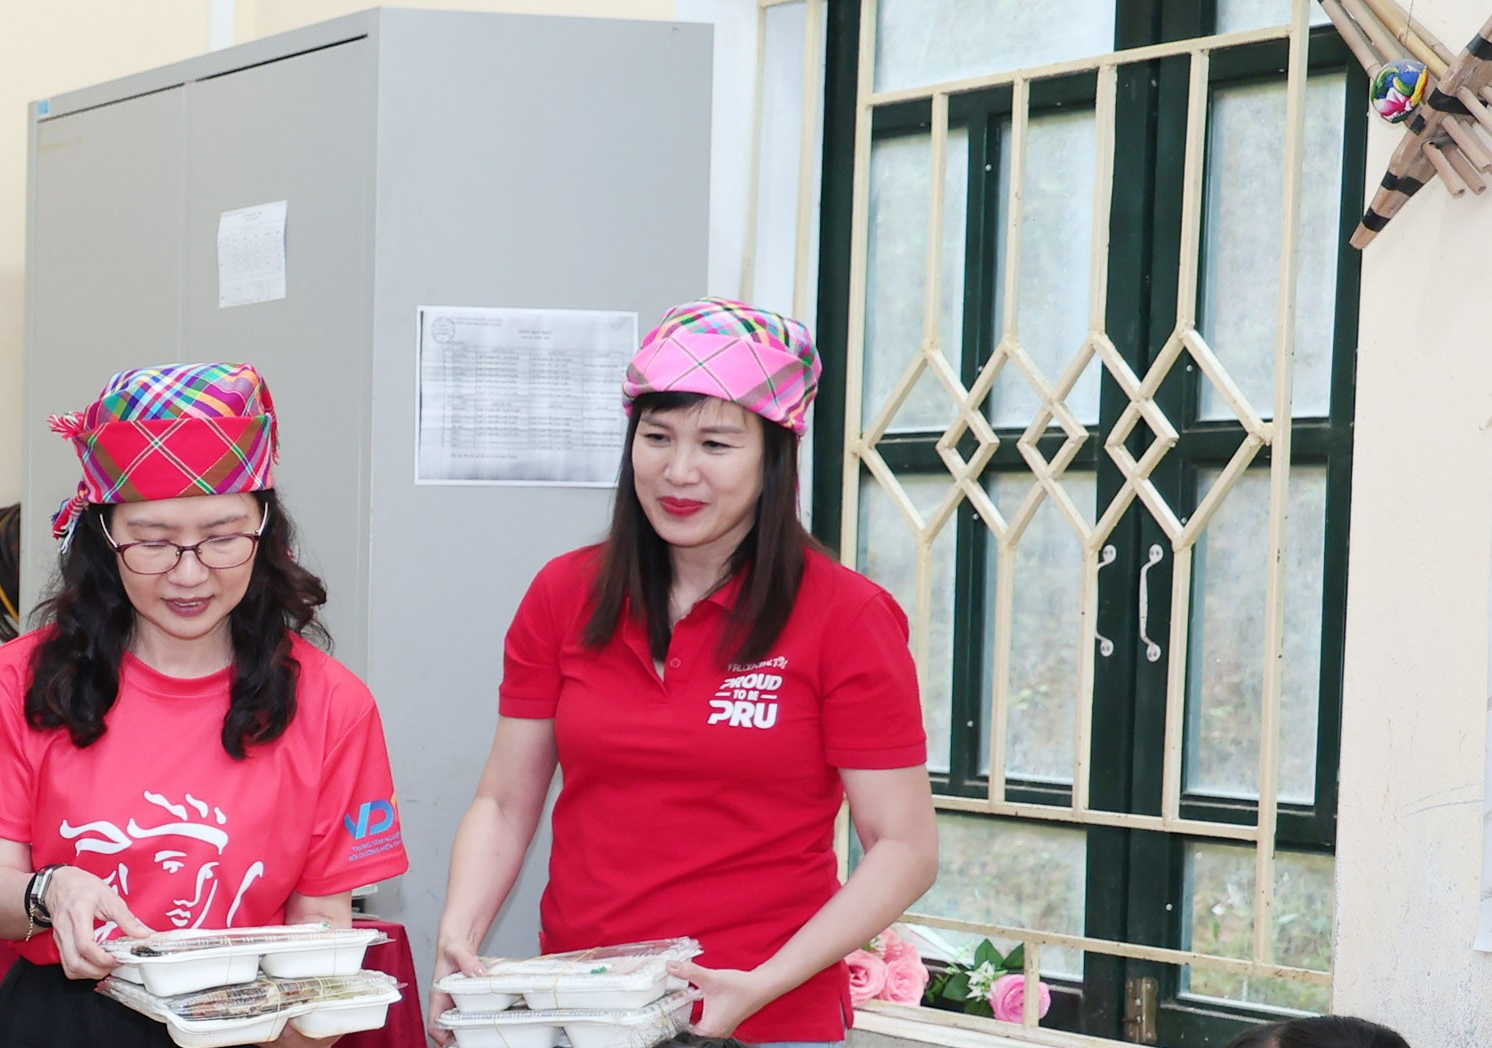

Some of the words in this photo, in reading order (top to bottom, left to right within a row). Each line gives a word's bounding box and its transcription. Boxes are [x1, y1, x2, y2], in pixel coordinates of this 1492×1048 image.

[719, 673, 783, 690] PROUD
[733, 689, 747, 700] TO
[748, 690, 759, 701] BE
[707, 700, 778, 729] PRU
